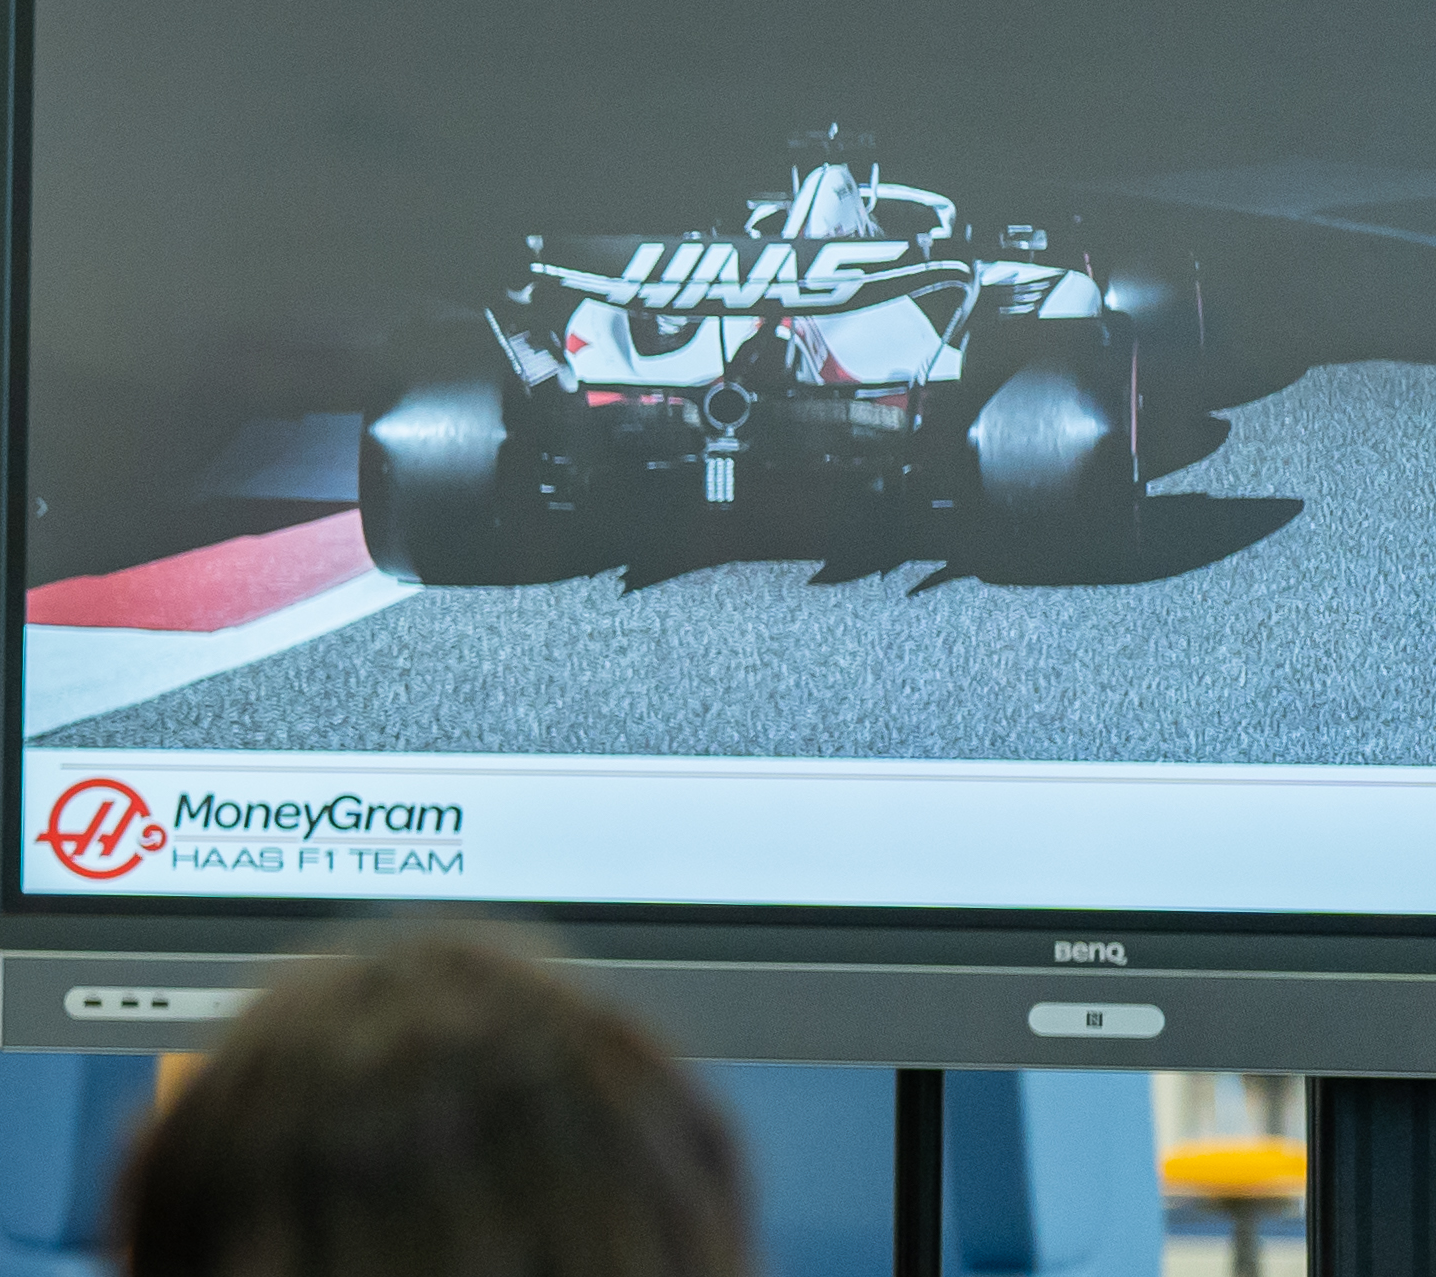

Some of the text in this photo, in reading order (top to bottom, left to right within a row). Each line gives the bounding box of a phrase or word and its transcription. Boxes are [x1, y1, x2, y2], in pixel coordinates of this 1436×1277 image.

[604, 240, 910, 309] HAAS
[173, 791, 463, 841] MoneyGram
[172, 846, 464, 876] HAAS F1 TEAM
[1054, 940, 1128, 966] BenQ
